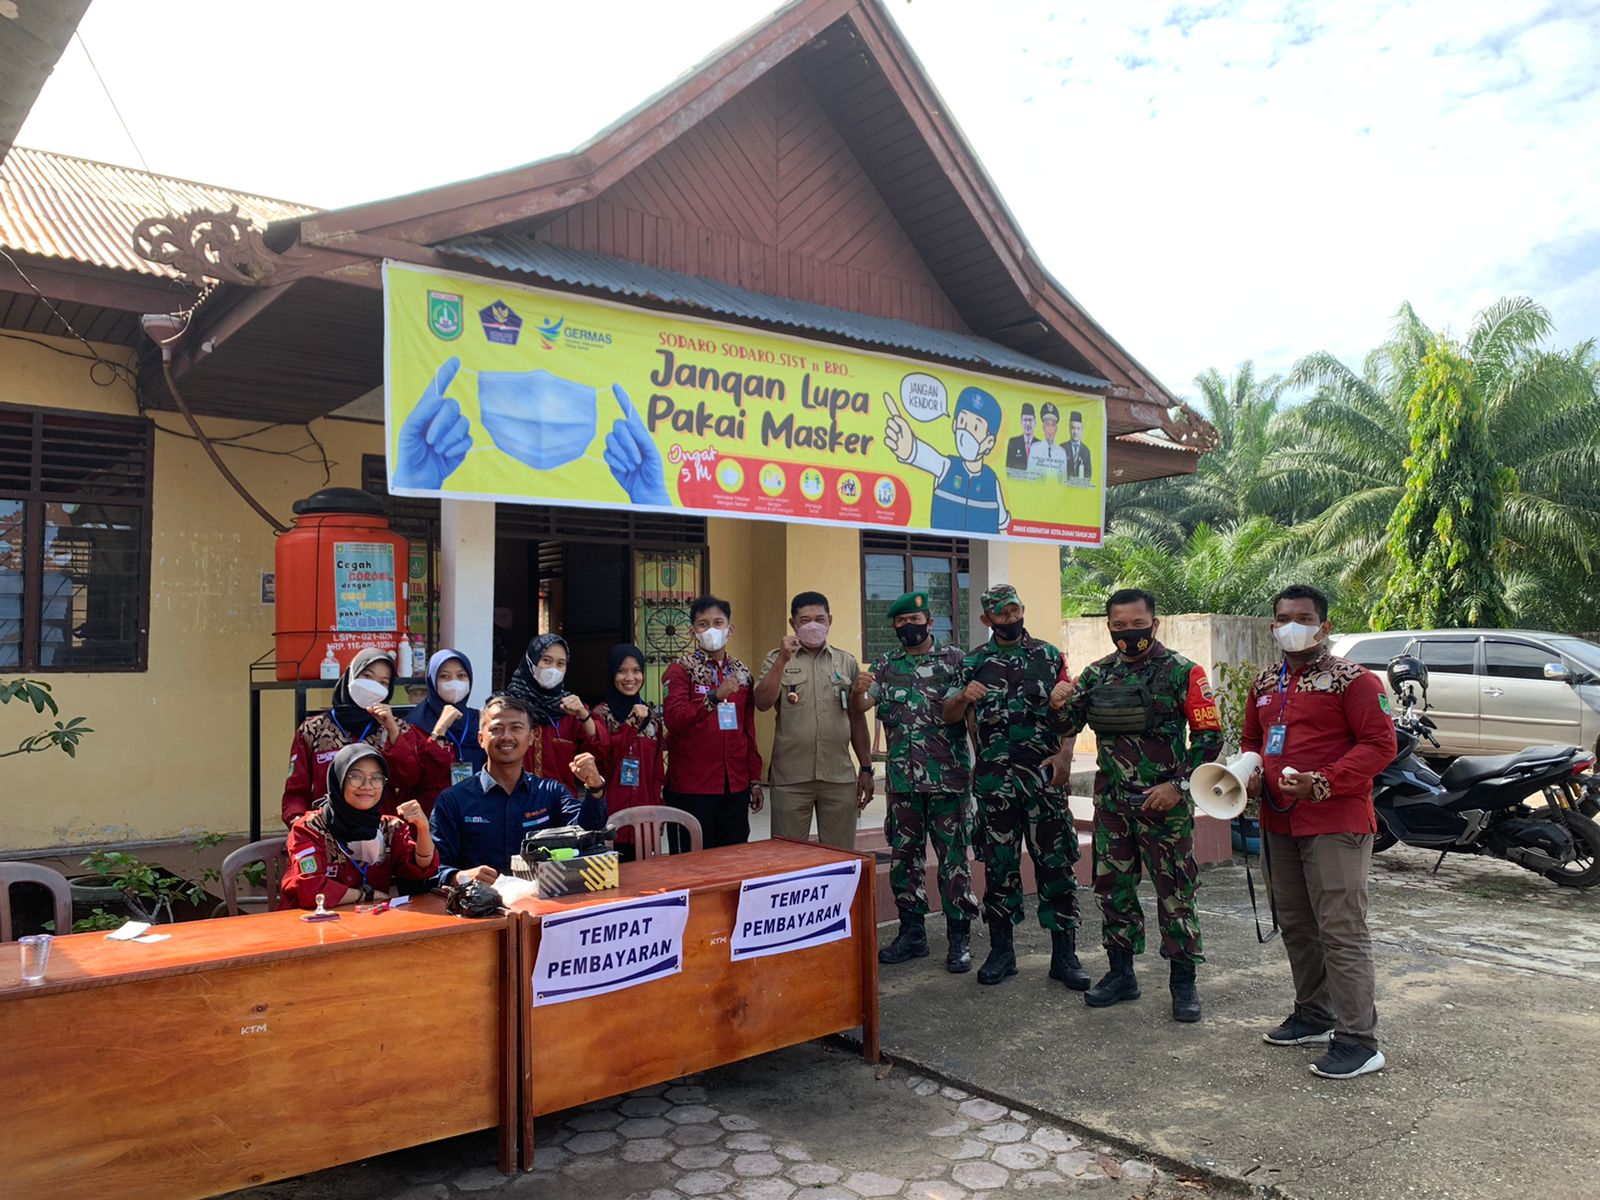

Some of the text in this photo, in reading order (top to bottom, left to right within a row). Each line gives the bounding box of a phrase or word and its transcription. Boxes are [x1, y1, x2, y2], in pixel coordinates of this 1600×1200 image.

[564, 327, 612, 344] GERMAS
[658, 332, 717, 353] SODARO
[801, 373, 869, 420] Lupa
[909, 382, 938, 397] JANGAN
[647, 394, 874, 455] Pakai Masker
[681, 467, 691, 482] 5
[770, 885, 829, 909] TEMPAT
[580, 917, 653, 946] TEMPAT
[743, 903, 841, 938] PEMBAYARAN
[548, 940, 672, 979] PEMBAYARAN
[240, 1023, 267, 1035] KTM
